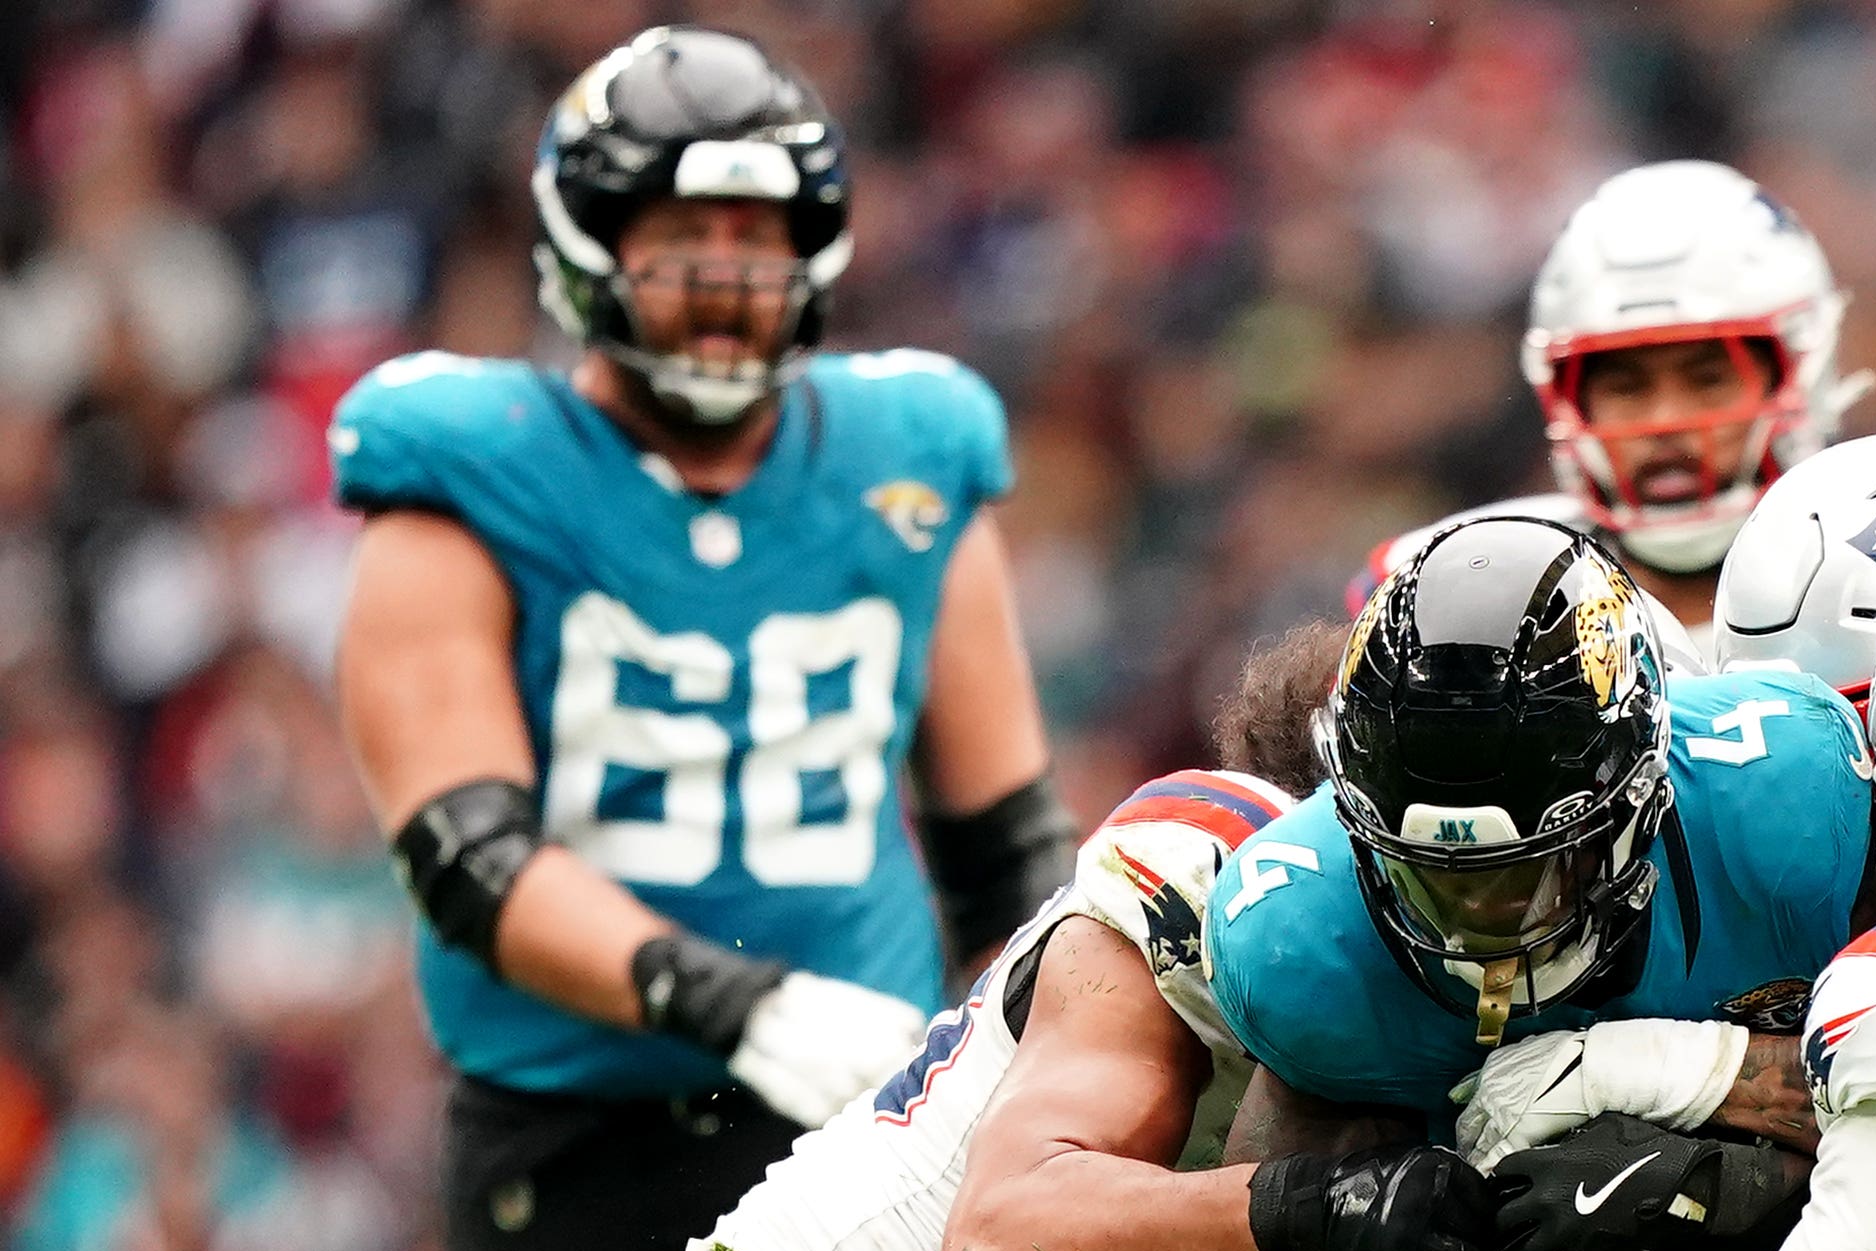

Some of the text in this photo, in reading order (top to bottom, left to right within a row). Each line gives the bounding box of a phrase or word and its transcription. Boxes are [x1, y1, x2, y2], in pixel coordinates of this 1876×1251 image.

[543, 591, 903, 888] 68
[1684, 698, 1791, 768] 4
[1433, 818, 1478, 843] JAX
[1223, 840, 1324, 927] 4
